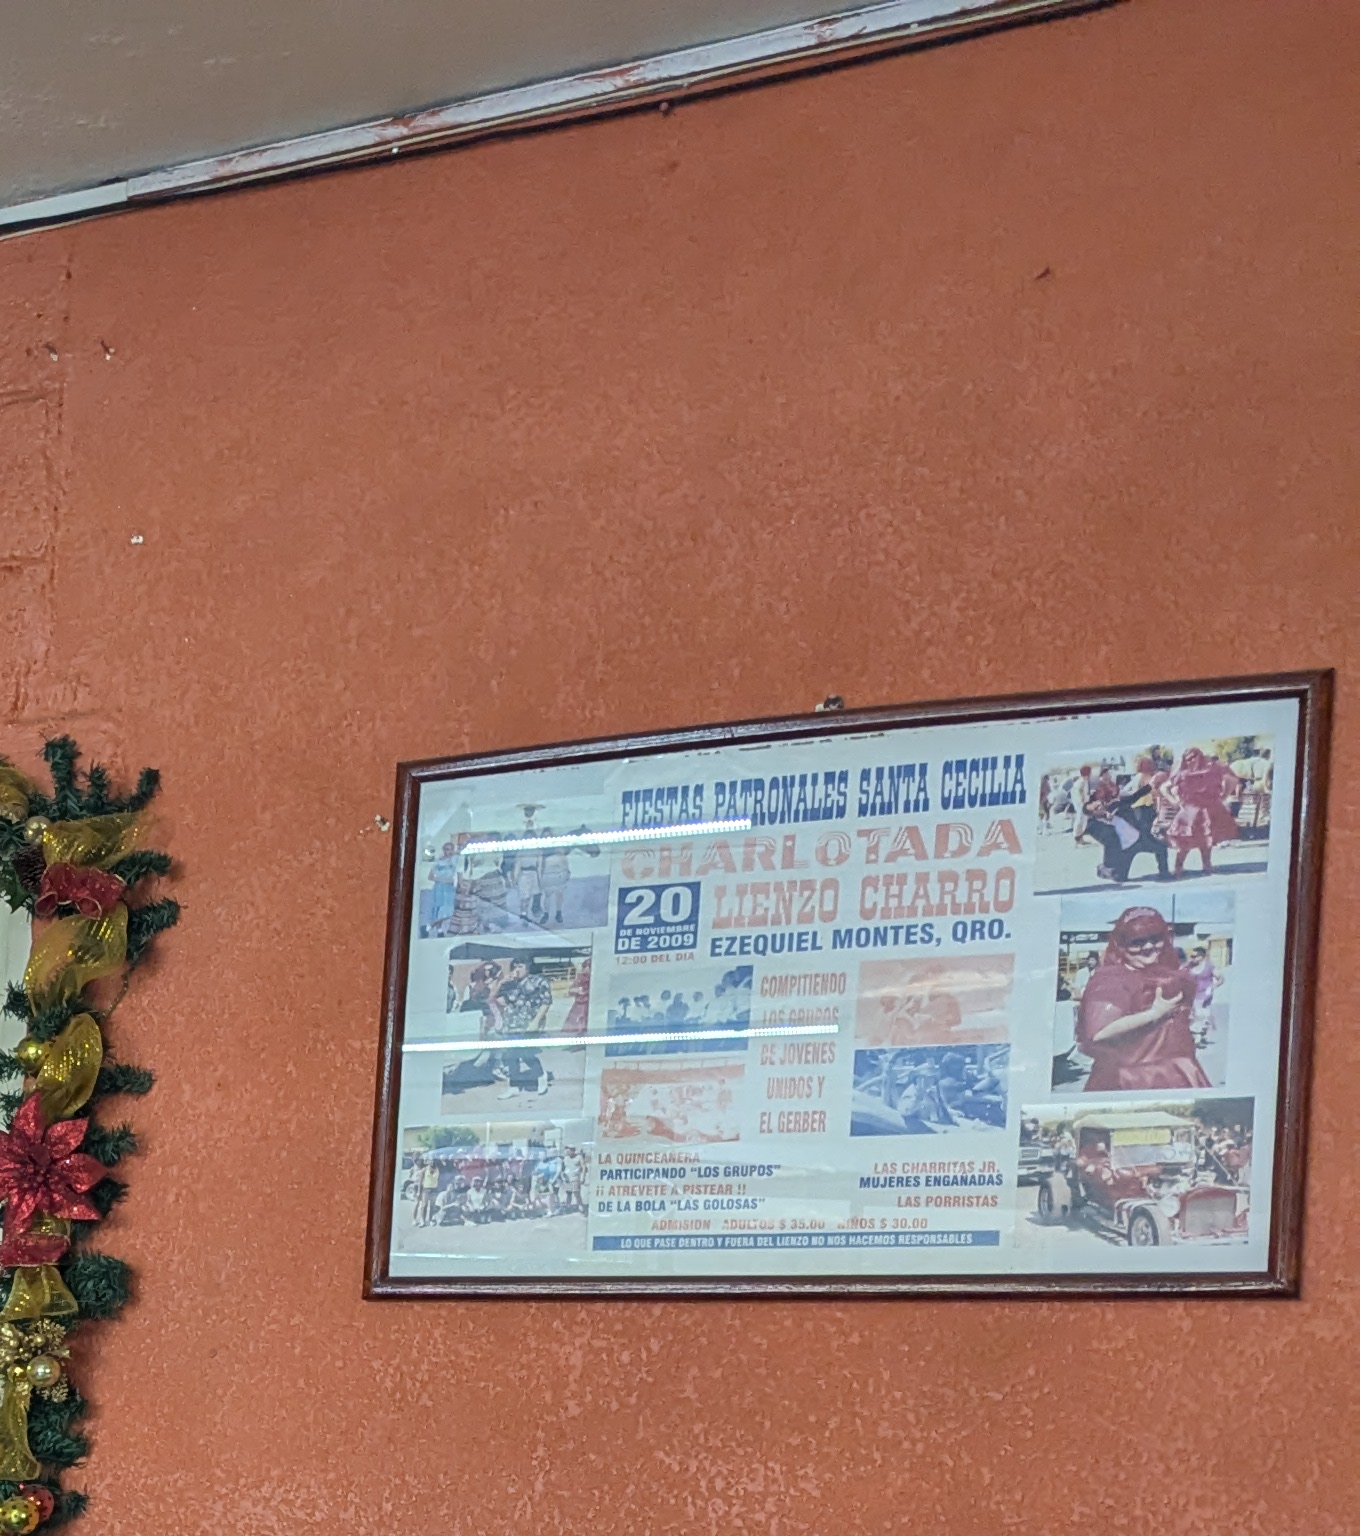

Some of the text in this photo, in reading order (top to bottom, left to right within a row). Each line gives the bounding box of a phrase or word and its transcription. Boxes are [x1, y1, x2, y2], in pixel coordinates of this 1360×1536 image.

[621, 753, 1028, 829] FIESTAS PATRONALES SANTA CECILIA
[621, 818, 1023, 881] CHARLOTADA
[623, 885, 693, 926] 20
[711, 865, 1018, 930] LIENZO CHARRO
[619, 923, 697, 937] DE NOVIEMBRE
[709, 918, 1012, 958] EZEQUIEL MONTES, QRO.
[617, 933, 695, 951] DE 2009
[650, 953, 671, 963] DEL
[760, 972, 847, 998] COMPITIENDO
[760, 1042, 836, 1066] DE JOVENES
[766, 1075, 826, 1100] UNIDOS Y
[759, 1110, 827, 1134] EL GERBER
[598, 1153, 612, 1165] LA
[600, 1167, 686, 1181] PARTICIPANDO
[874, 1160, 1000, 1175] LAS CHARRITAS JR.
[608, 1184, 667, 1197] ATREVETE
[670, 1185, 678, 1196] A
[683, 1183, 734, 1196] PISTEAR
[737, 1183, 747, 1195] !!
[859, 1175, 921, 1189] MUJERES
[598, 1201, 613, 1213] DE
[616, 1200, 631, 1212] LA
[635, 1200, 666, 1212] BOLA
[897, 1195, 998, 1208] LAS PORRISTAS
[651, 1218, 711, 1231] ADMISION
[722, 1218, 775, 1231] ADULTOS
[879, 1218, 887, 1230] $
[892, 1217, 928, 1230] 30.00
[620, 1233, 973, 1249] LO QUE PASE DENTRO Y FUERA DEL LIENZO NO NOS HACEMOS RESPONSABLES
